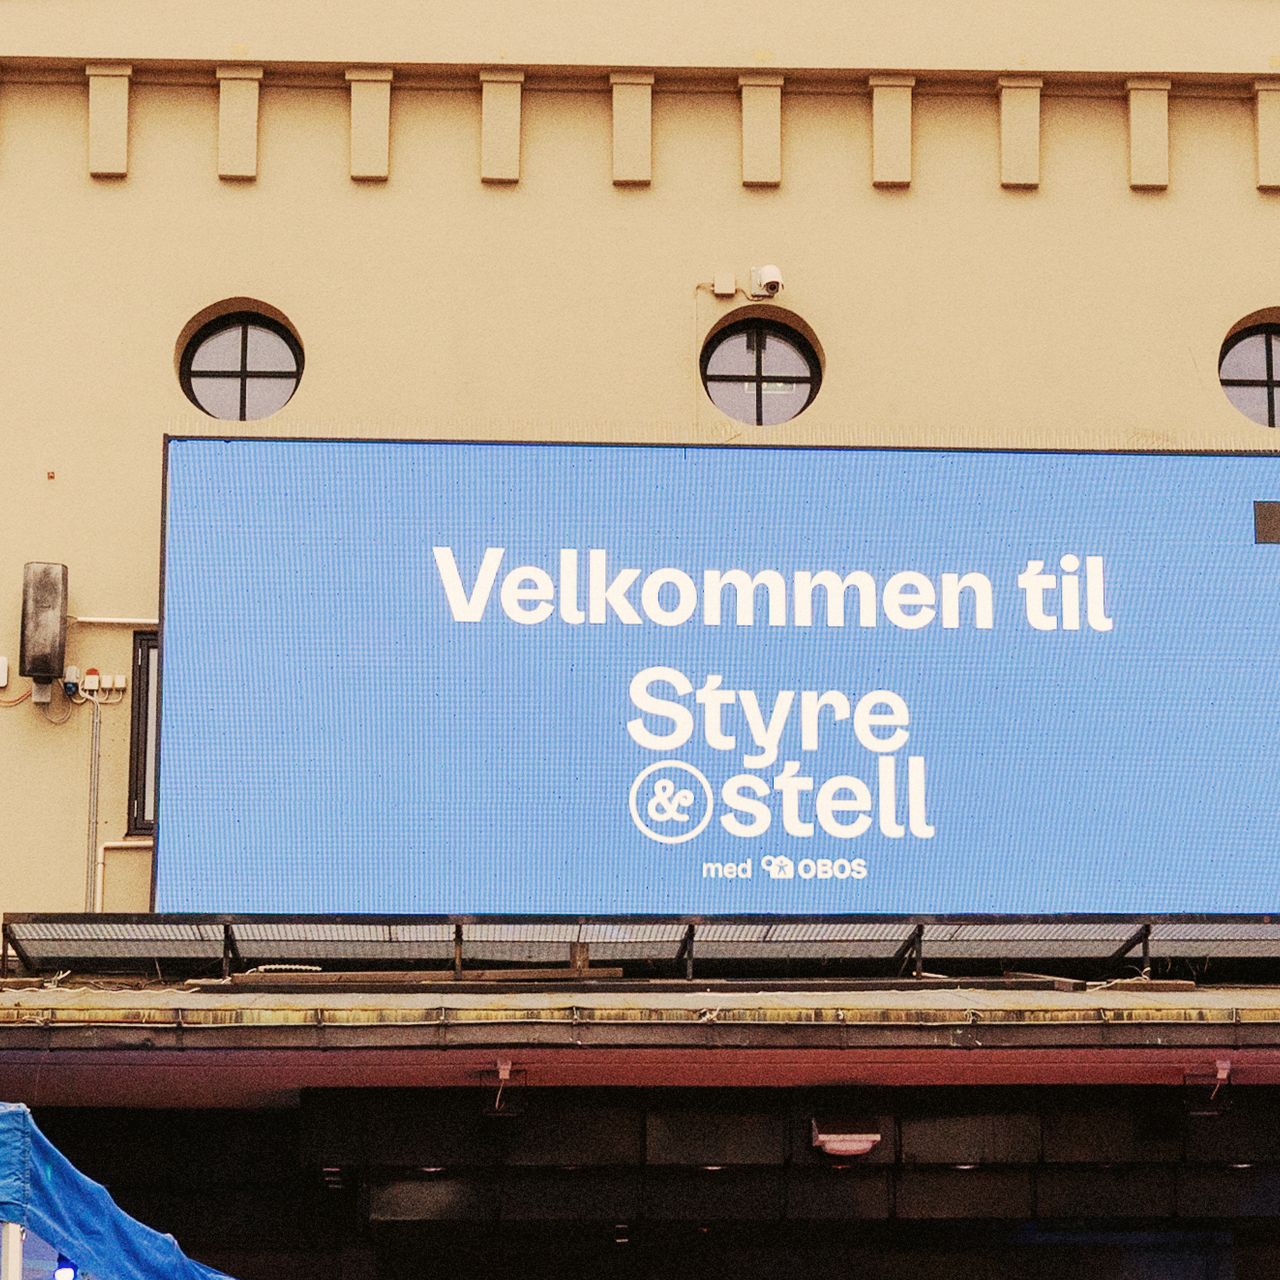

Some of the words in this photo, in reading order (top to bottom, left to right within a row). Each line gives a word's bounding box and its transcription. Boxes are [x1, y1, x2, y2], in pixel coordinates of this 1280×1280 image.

[433, 545, 995, 629] Velkommen
[1019, 553, 1114, 633] til
[627, 665, 910, 768] Styre
[720, 752, 935, 839] stell
[702, 857, 752, 878] med
[797, 857, 868, 879] OBOS
